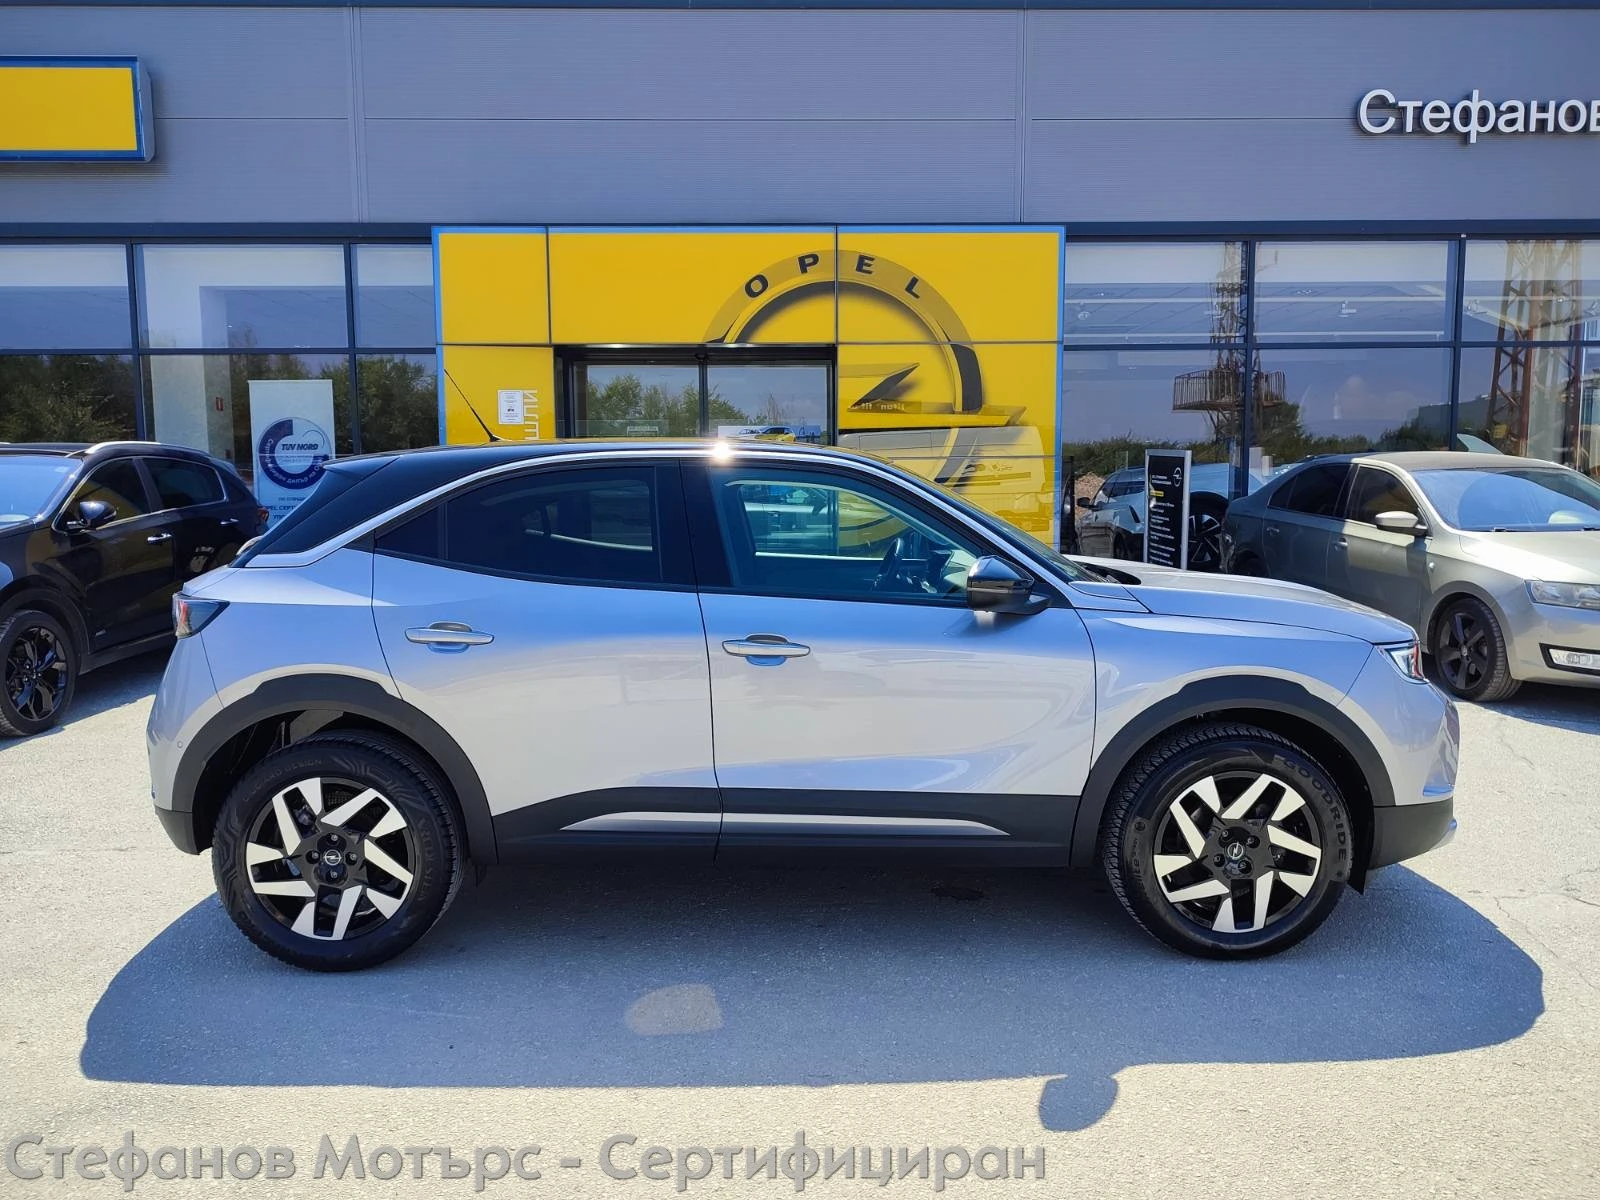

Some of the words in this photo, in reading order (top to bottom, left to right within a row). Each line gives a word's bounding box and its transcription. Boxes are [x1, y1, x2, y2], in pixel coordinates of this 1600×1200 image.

[744, 253, 920, 299] OPEL
[297, 443, 319, 451] NORD
[1284, 760, 1347, 861] GOODRIDE
